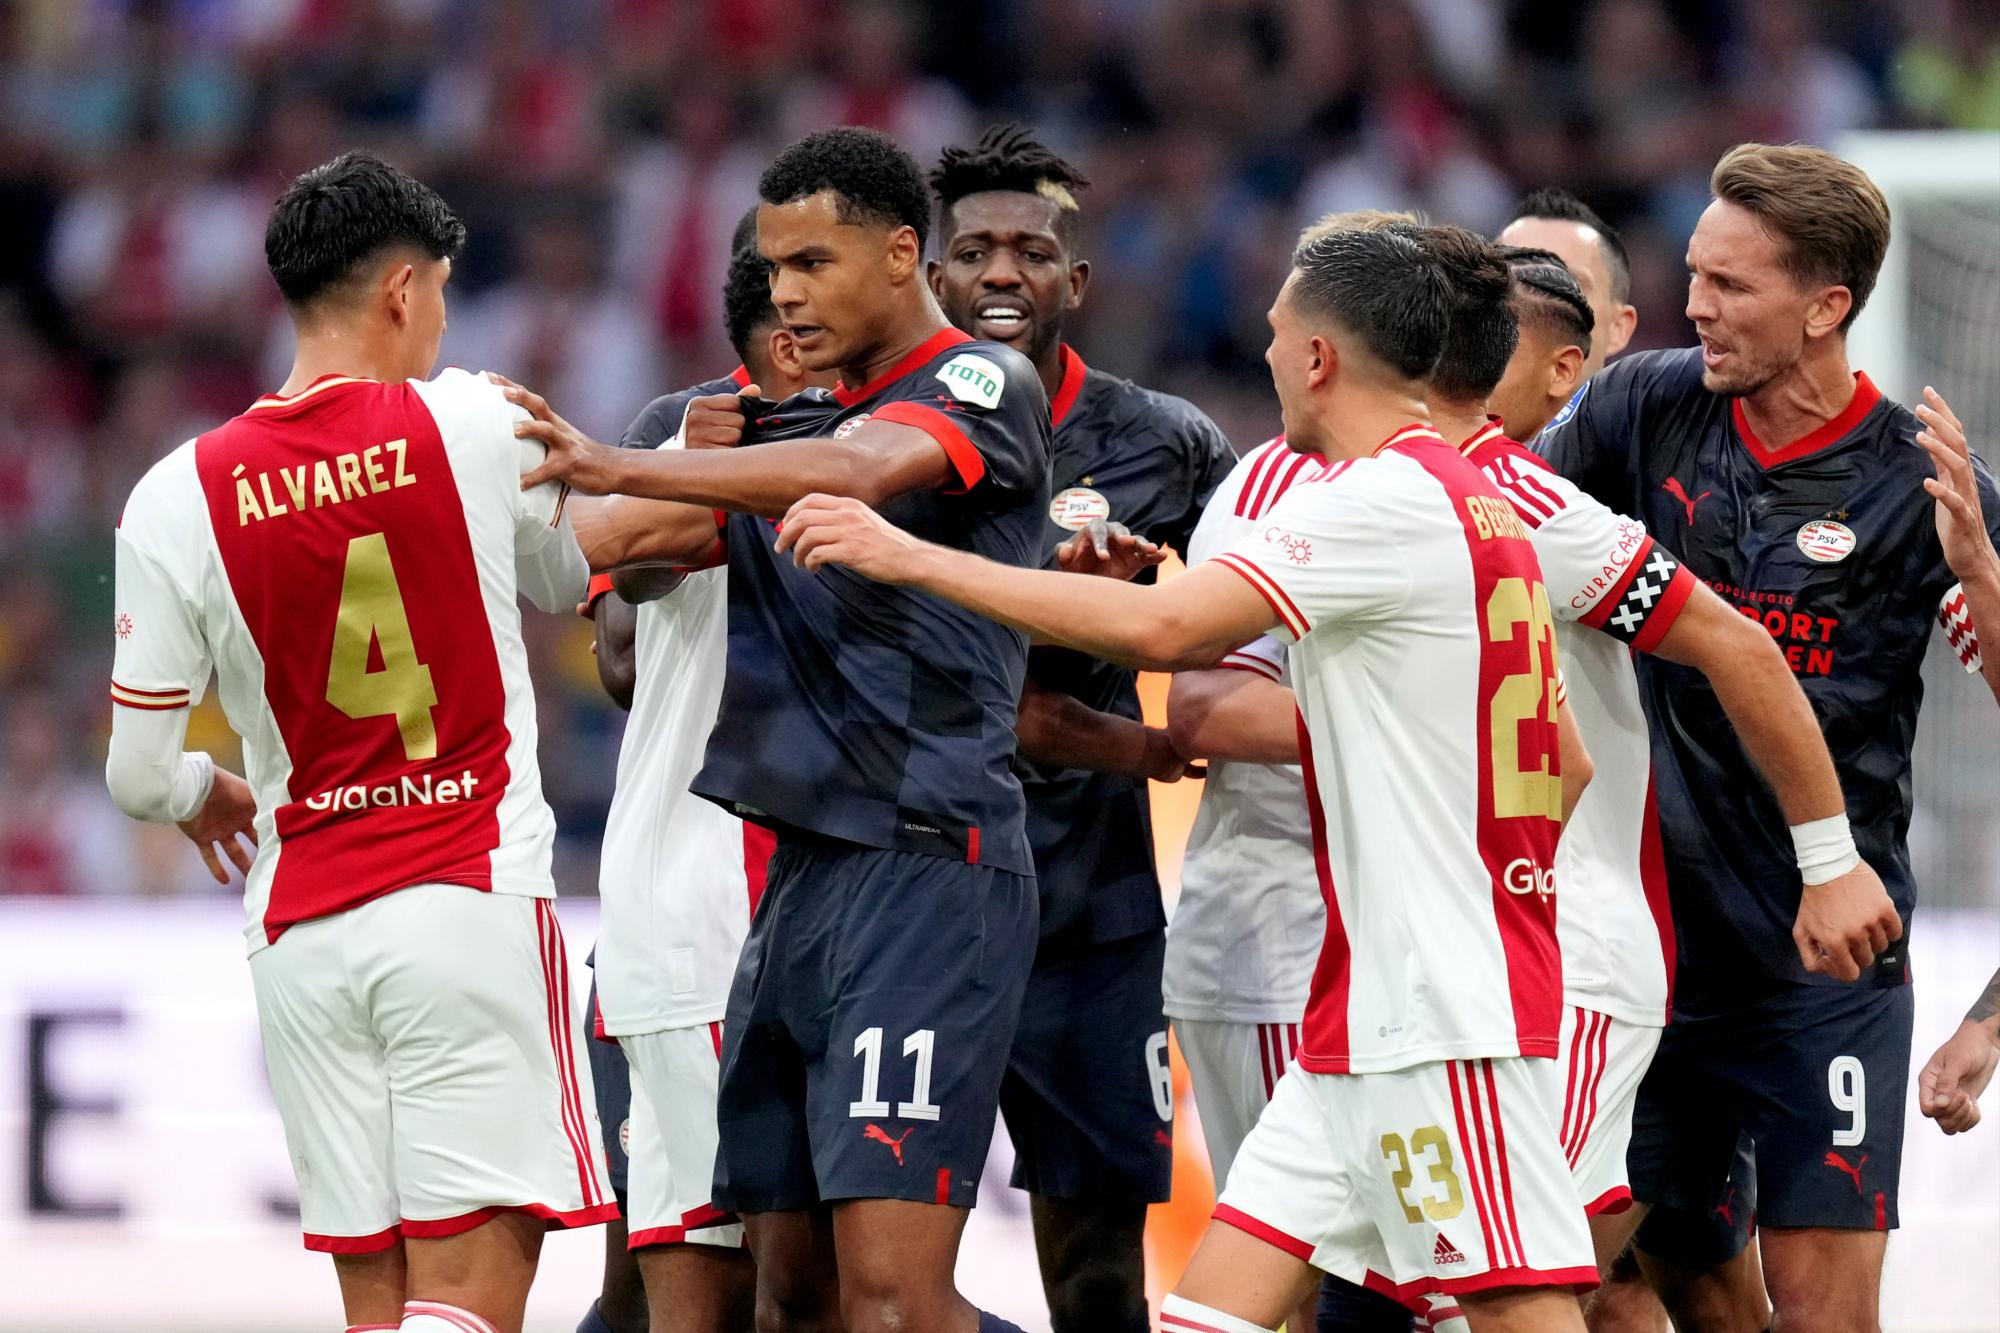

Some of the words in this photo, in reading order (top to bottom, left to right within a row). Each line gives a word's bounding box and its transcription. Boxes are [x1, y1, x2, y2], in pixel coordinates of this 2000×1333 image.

[948, 363, 998, 398] TOTO
[231, 438, 416, 527] ÁLVAREZ
[1070, 503, 1089, 511] PSV
[1817, 534, 1839, 545] PSV
[325, 532, 438, 761] 4
[1487, 577, 1562, 822] 23
[849, 1027, 941, 1121] 11
[1145, 1031, 1173, 1122] 6
[1828, 1055, 1866, 1146] 9
[1380, 1125, 1465, 1224] 23
[1434, 1252, 1465, 1265] adidas
